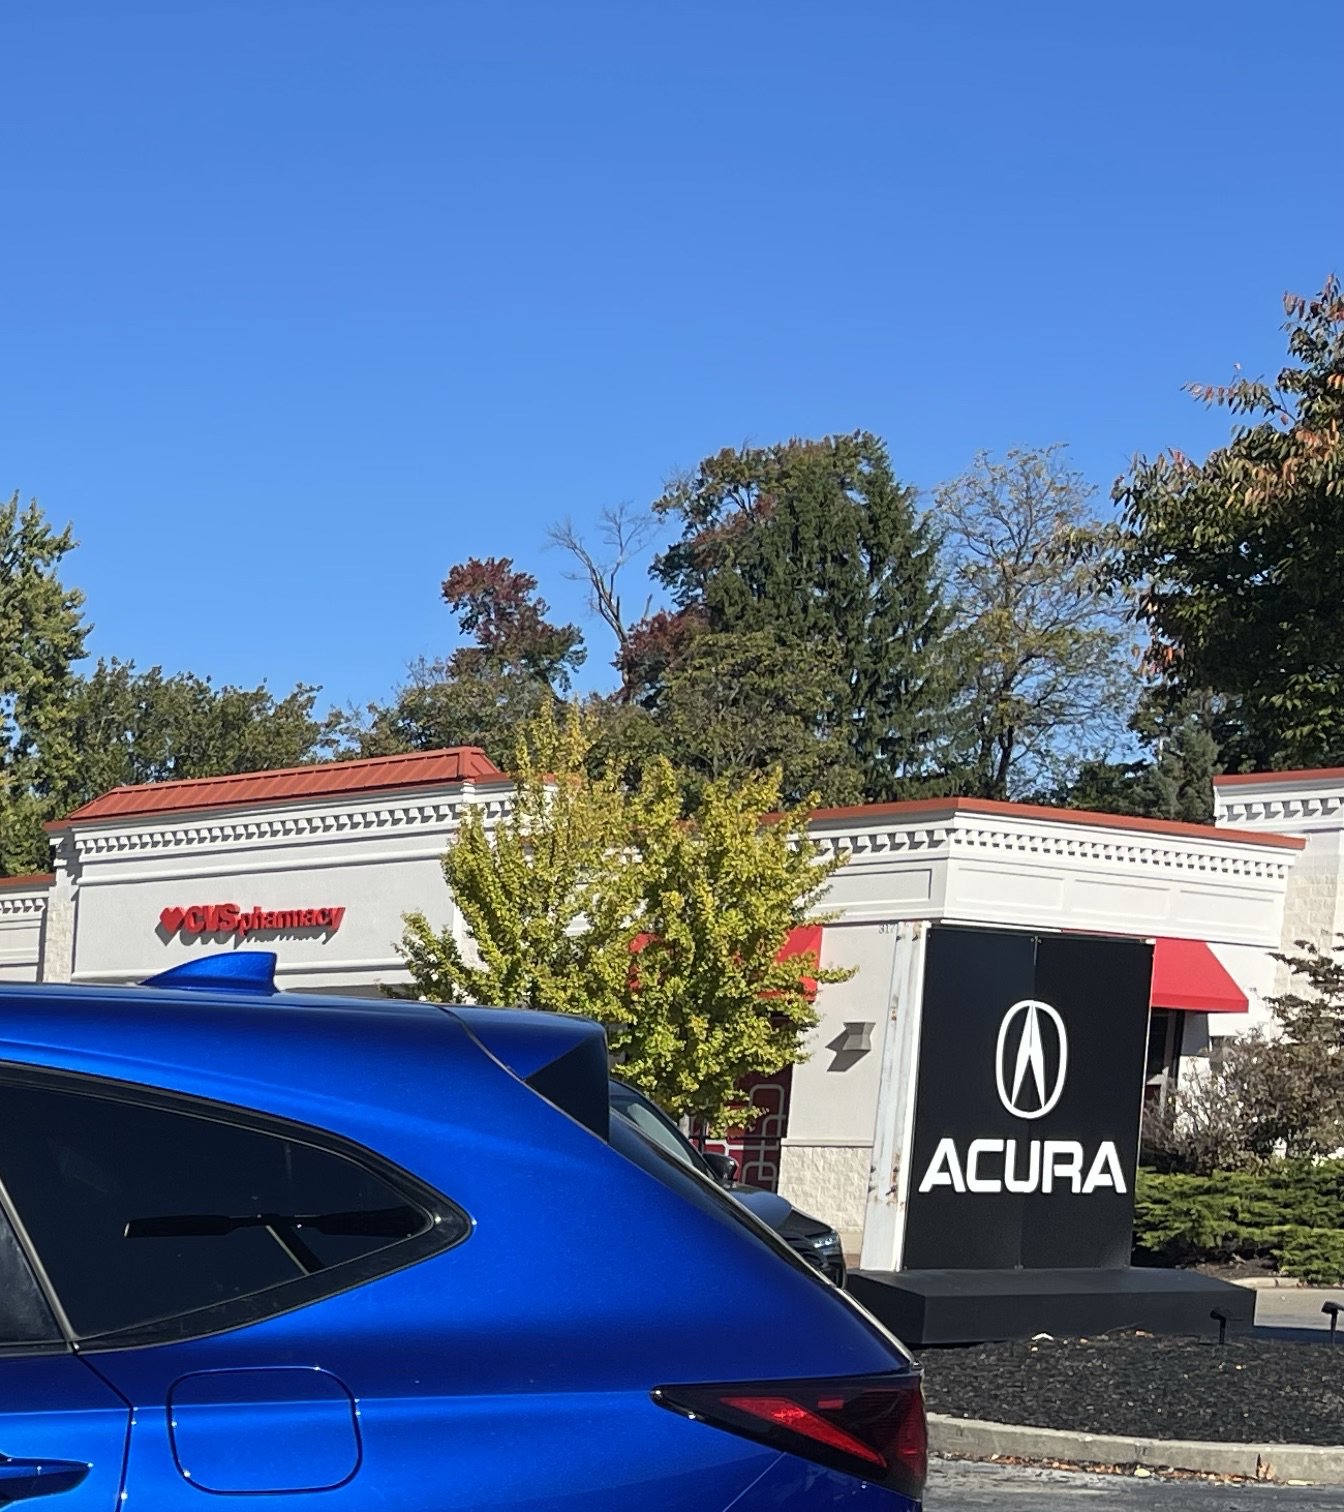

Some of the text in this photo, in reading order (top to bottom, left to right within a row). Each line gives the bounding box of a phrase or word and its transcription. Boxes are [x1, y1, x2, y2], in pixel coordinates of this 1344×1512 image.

[184, 903, 346, 937] CVS pharmacy
[918, 1137, 1128, 1194] ACURA
